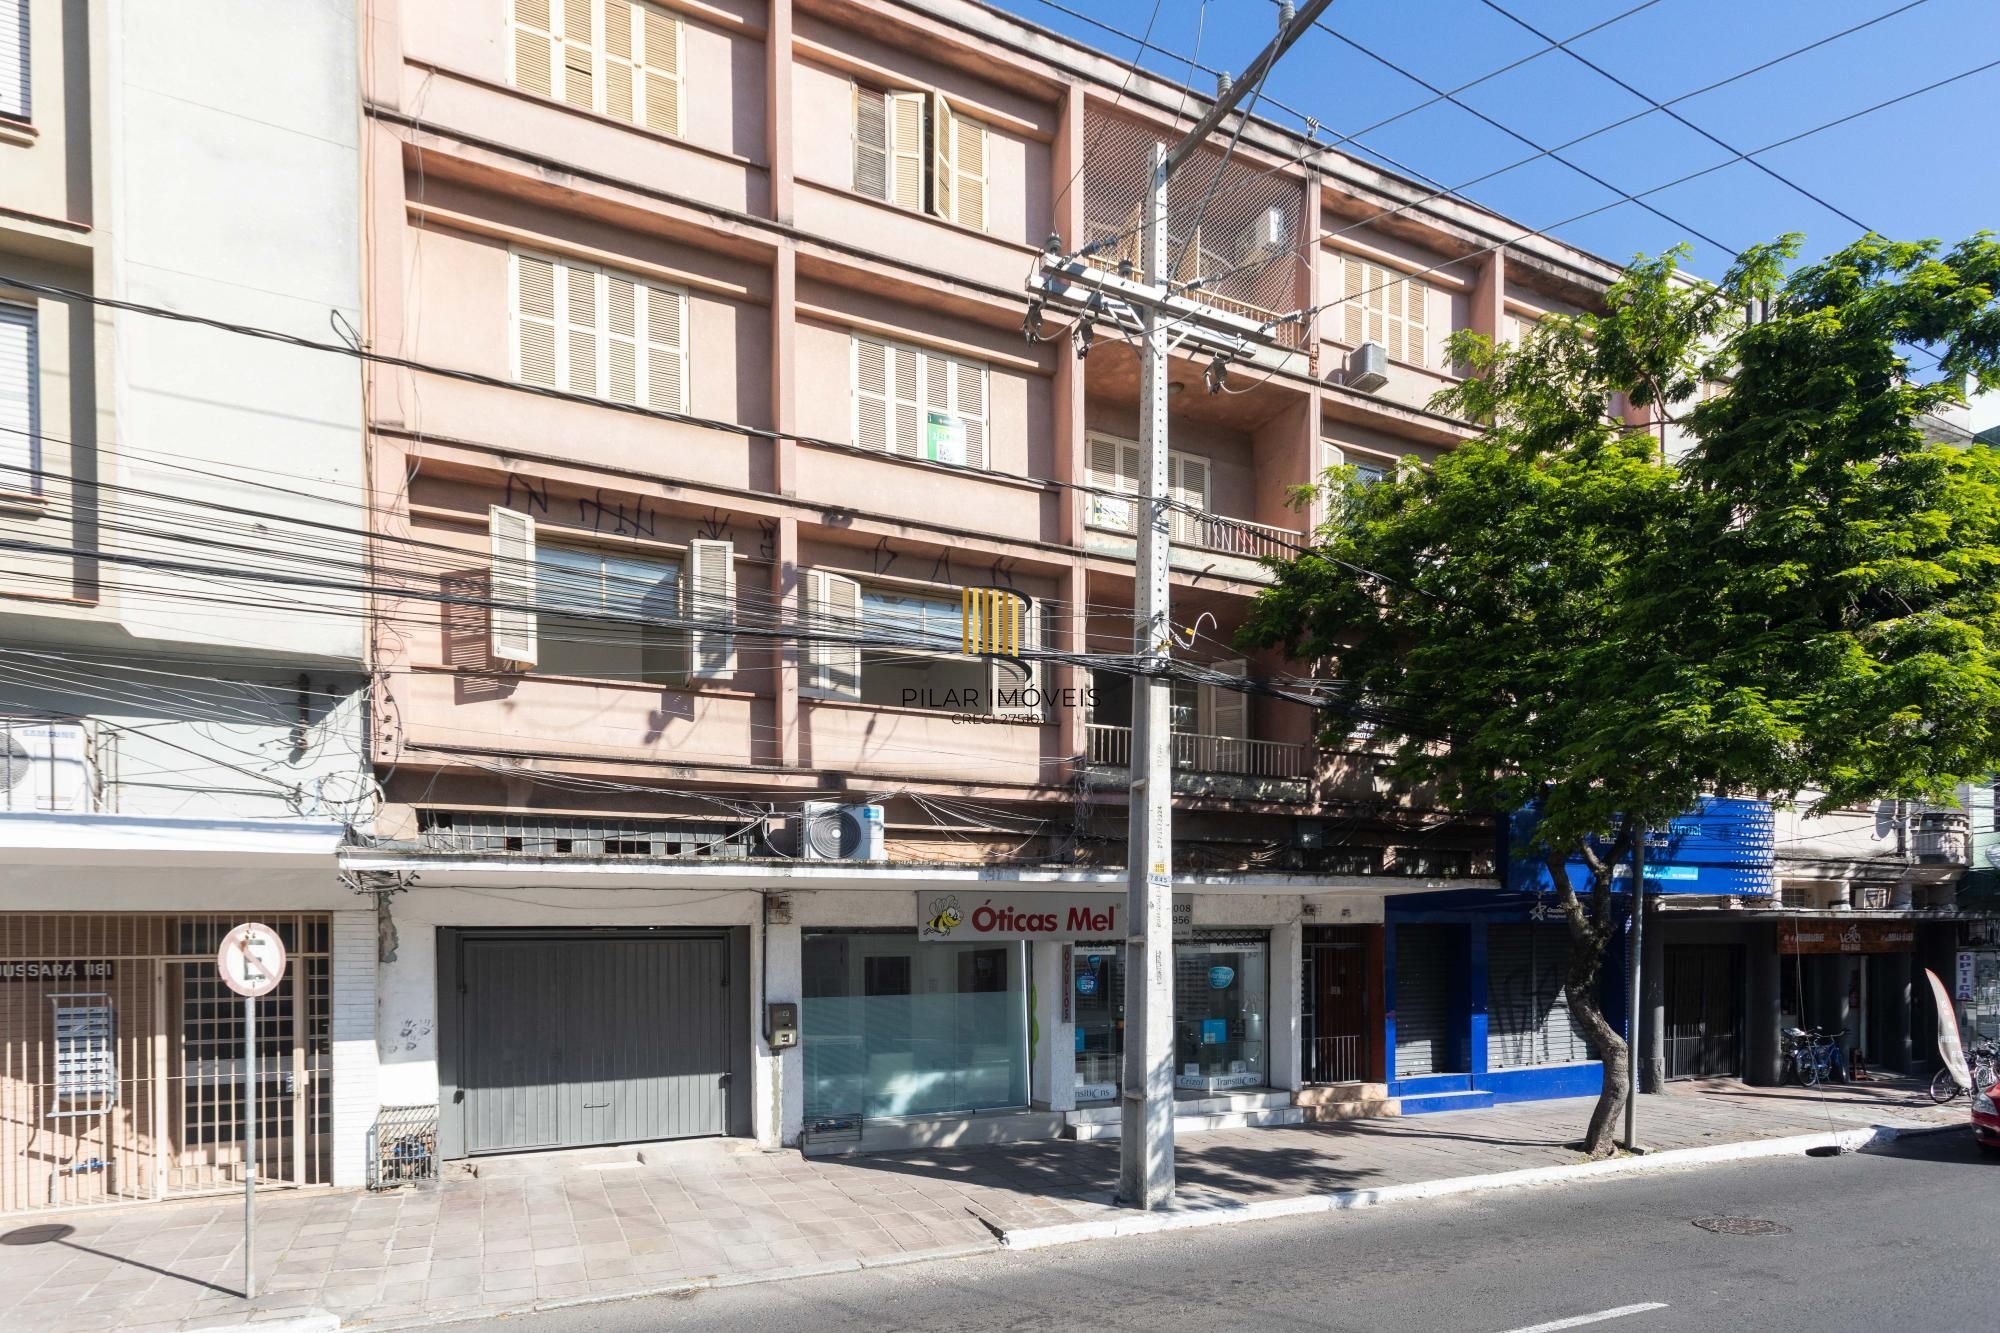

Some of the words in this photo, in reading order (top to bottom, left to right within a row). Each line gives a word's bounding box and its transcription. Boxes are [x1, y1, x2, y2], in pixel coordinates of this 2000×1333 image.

[972, 899, 1058, 932] Óticas
[1066, 905, 1115, 931] Mel
[84, 963, 113, 976] 1181
[1074, 1088, 1110, 1099] nsitions
